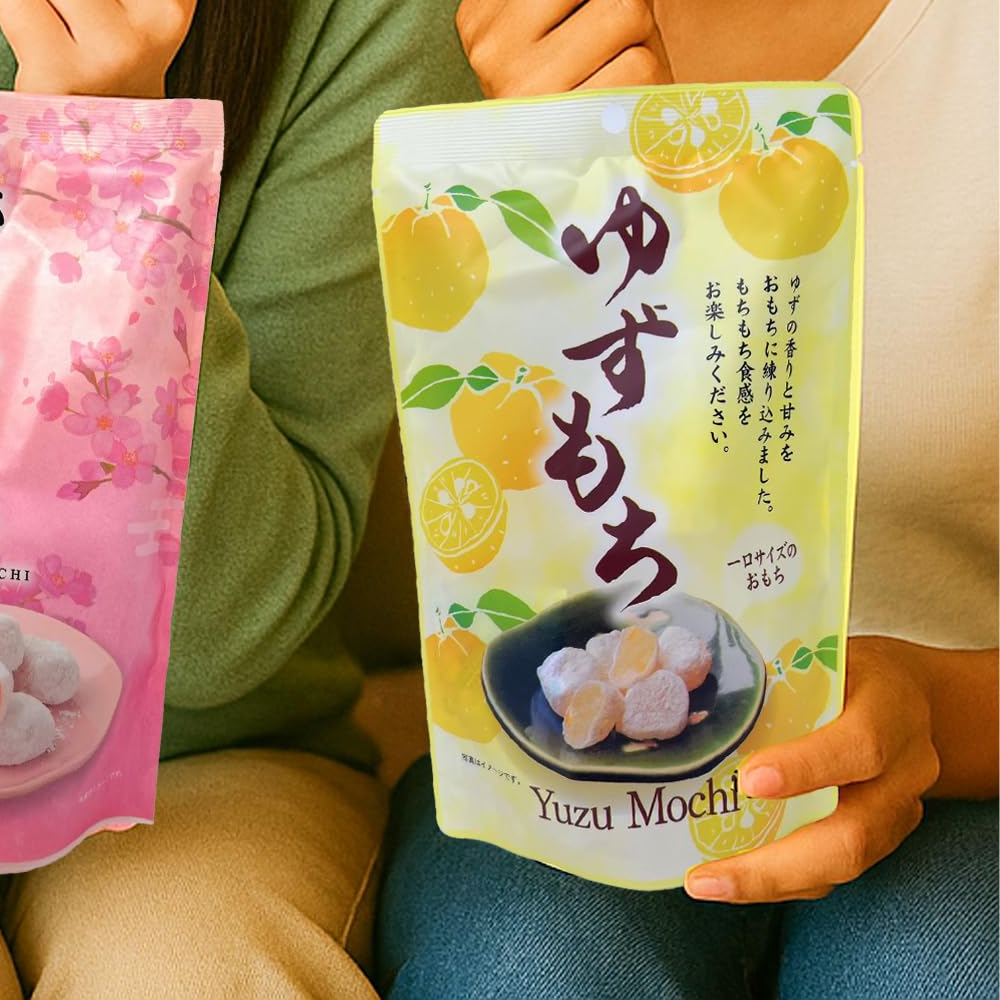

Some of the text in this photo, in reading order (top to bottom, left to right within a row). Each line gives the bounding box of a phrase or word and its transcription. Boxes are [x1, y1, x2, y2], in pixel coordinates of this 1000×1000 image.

[545, 186, 678, 611] ゆずもち
[705, 281, 729, 453] お楽しみください。
[736, 278, 755, 426] もちもち食感を
[757, 275, 779, 513] おもちに練り込みました。
[779, 275, 801, 462] ゆずの香りと甘みを
[727, 541, 797, 569] 一口サイズの
[746, 565, 785, 591] おもち
[529, 769, 741, 831] Yuzu Mochi
